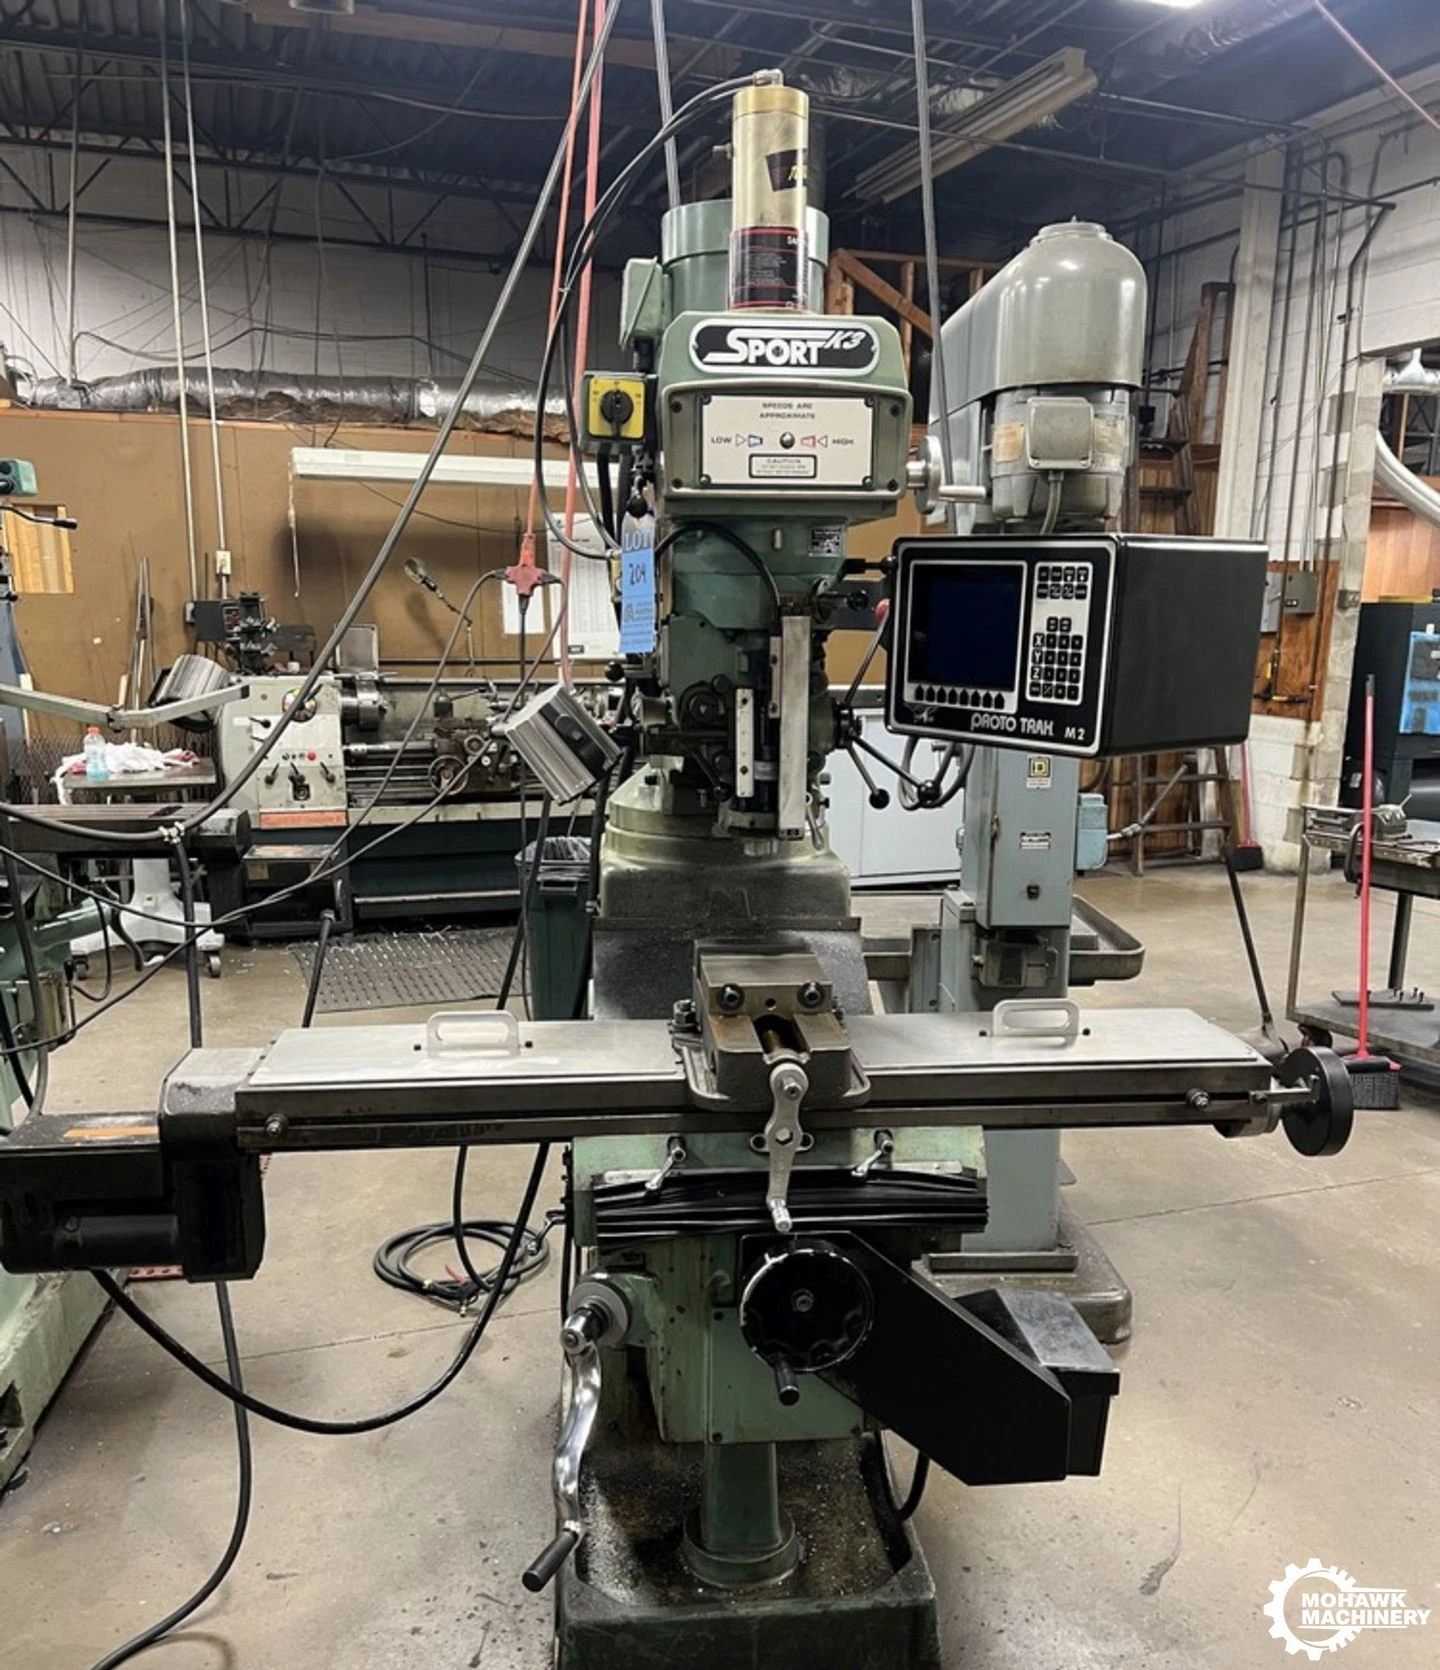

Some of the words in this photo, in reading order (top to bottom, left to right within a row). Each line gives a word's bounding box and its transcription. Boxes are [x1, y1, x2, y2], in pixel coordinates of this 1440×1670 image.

[703, 328, 835, 366] SPORT
[823, 331, 867, 349] K3
[1034, 635, 1043, 646] X
[1034, 651, 1041, 662] Y
[1032, 667, 1040, 678] Z
